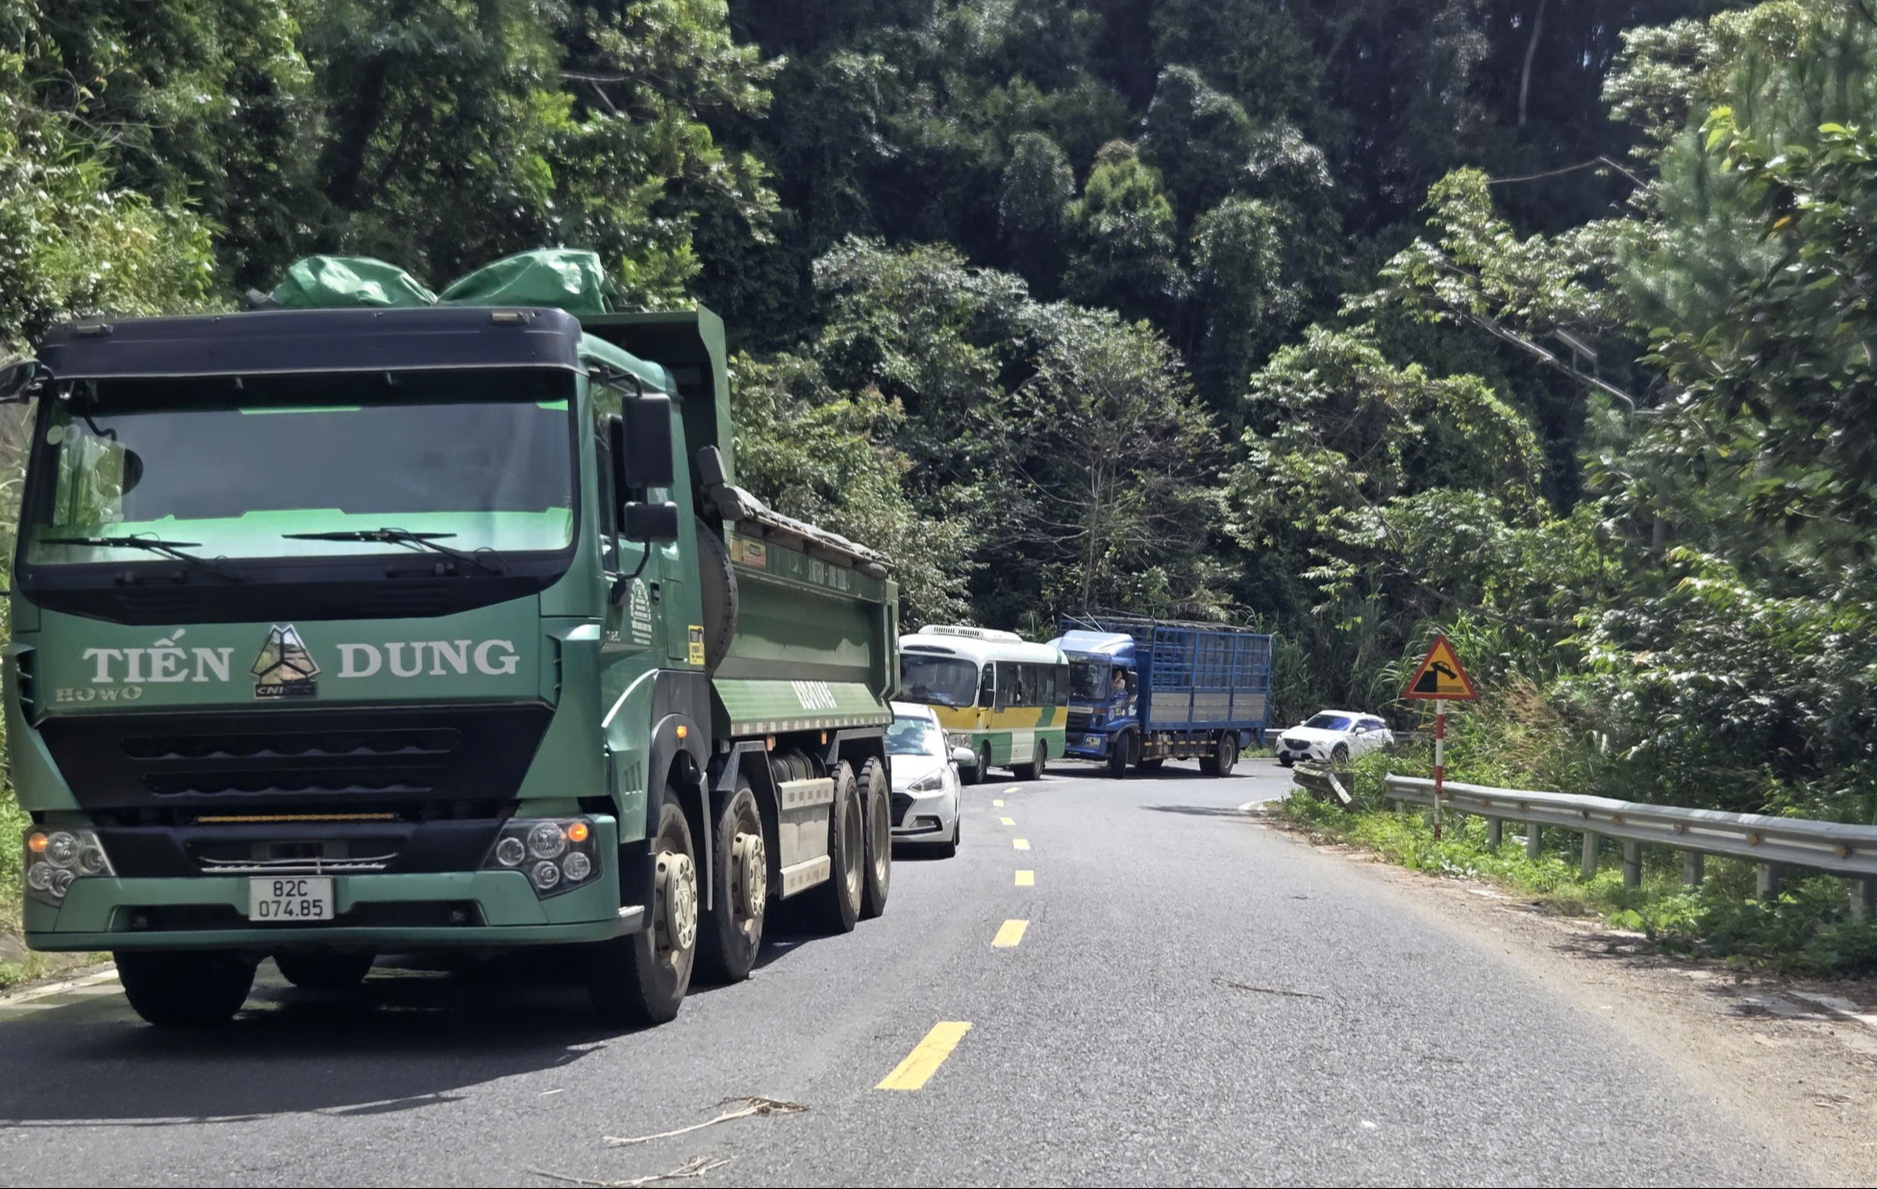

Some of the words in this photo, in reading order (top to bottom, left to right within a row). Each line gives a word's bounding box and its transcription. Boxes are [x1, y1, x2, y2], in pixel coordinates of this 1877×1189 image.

[82, 628, 234, 683] TIẾN
[336, 639, 520, 678] DUNG
[55, 685, 143, 702] HOWO
[273, 880, 308, 898] 82C
[259, 899, 323, 917] 074.85
